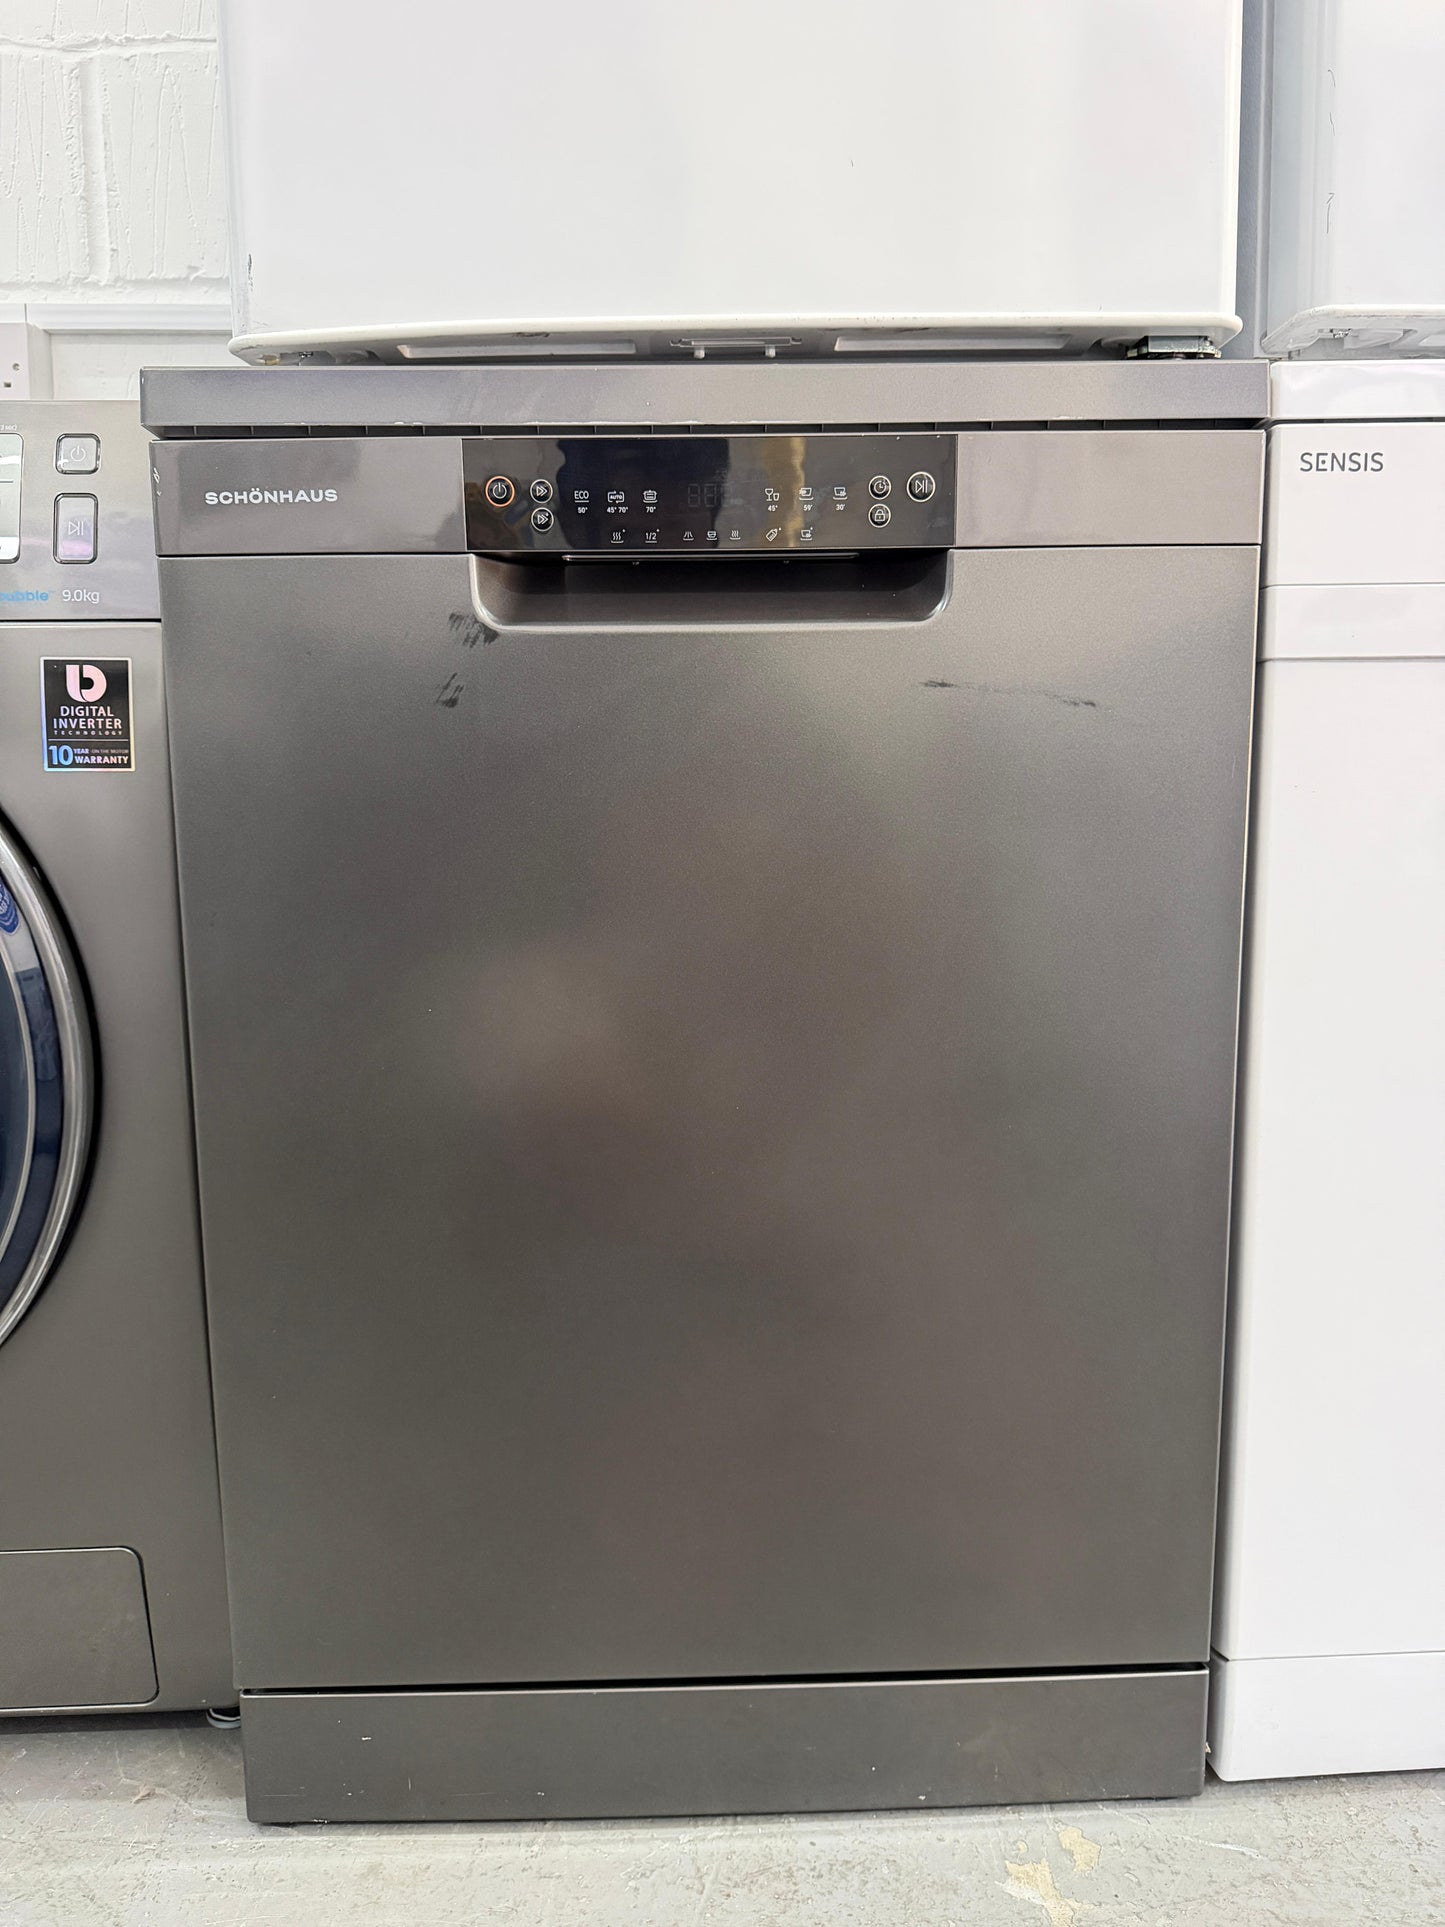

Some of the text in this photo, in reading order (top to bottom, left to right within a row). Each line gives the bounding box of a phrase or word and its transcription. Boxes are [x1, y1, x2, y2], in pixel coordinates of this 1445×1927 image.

[1300, 452, 1384, 472] SENSIS
[204, 487, 339, 505] SCHÖNHAUS
[574, 490, 589, 500] ECO
[62, 588, 100, 604] 9.0kg
[60, 705, 115, 717] DIGITAL
[53, 718, 122, 729] INVERTER
[48, 745, 74, 766] 10
[74, 755, 129, 764] WARRANTY
